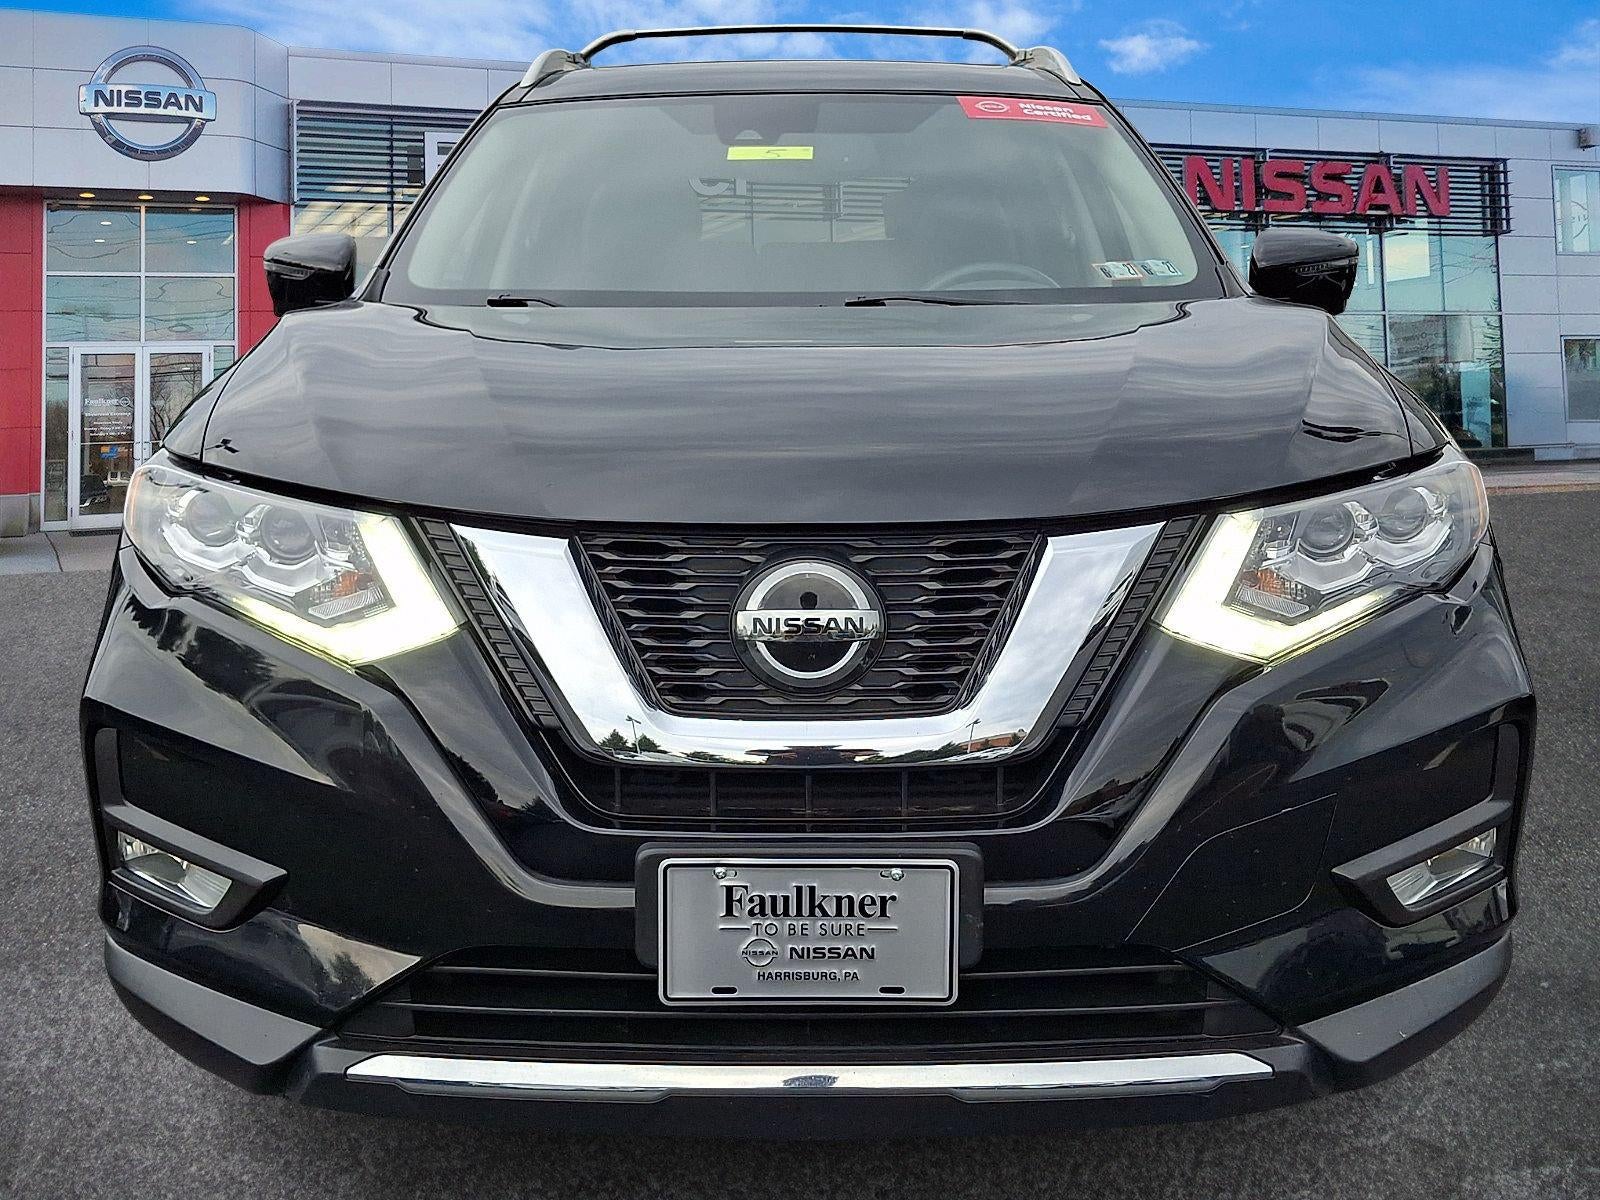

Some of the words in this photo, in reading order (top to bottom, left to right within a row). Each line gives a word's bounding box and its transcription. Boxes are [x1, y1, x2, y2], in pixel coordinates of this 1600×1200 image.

[93, 89, 204, 113] NISSAN
[1018, 103, 1074, 113] Nissan
[1023, 109, 1093, 121] Certified
[1183, 154, 1451, 217] NISSAN
[752, 616, 865, 635] NISSAN
[719, 884, 898, 919] Faulkner
[752, 923, 779, 937] TO
[787, 923, 810, 937] BE
[818, 922, 866, 937] SURE
[788, 946, 876, 961] NISSAN
[757, 970, 841, 982] HARRISBURG,
[843, 970, 860, 981] PA
